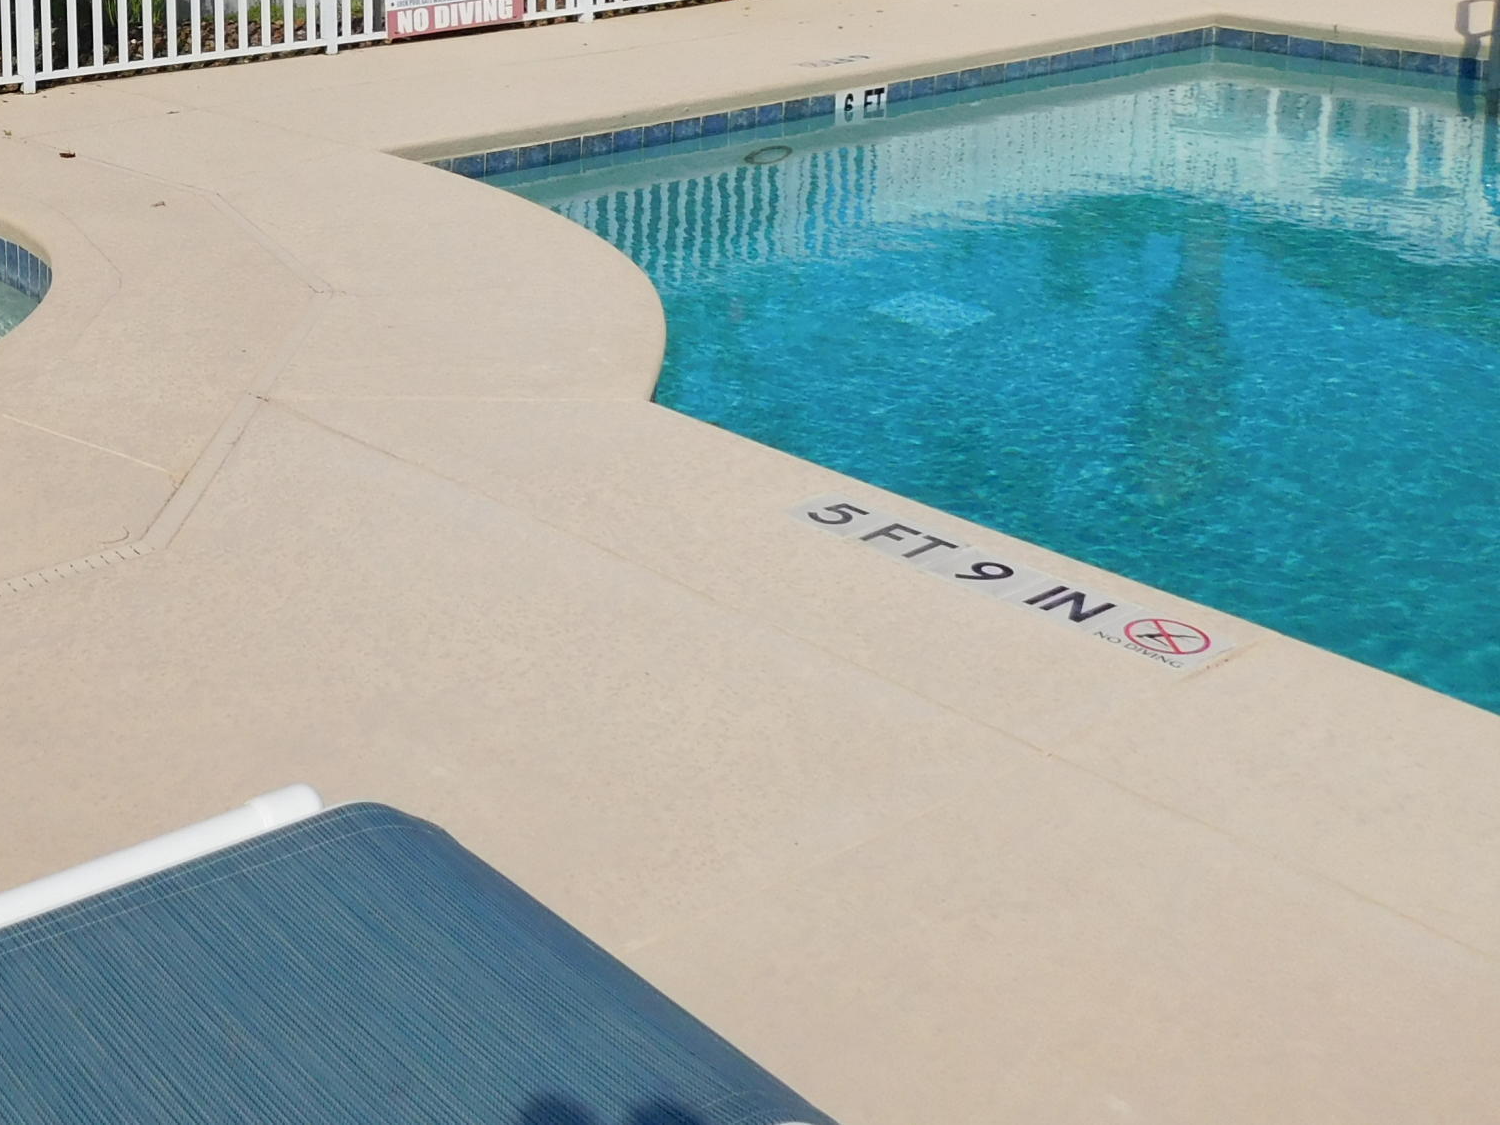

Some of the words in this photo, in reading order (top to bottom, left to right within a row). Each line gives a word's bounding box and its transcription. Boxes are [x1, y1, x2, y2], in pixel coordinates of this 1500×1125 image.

[397, 7, 429, 34] NO
[844, 93, 853, 111] 6
[864, 87, 884, 107] FT
[807, 503, 870, 525] 5
[859, 523, 959, 559] FT
[955, 561, 1014, 581] 9
[1023, 585, 1116, 623] IN
[1094, 631, 1121, 643] NO
[1124, 643, 1184, 668] DIVING
